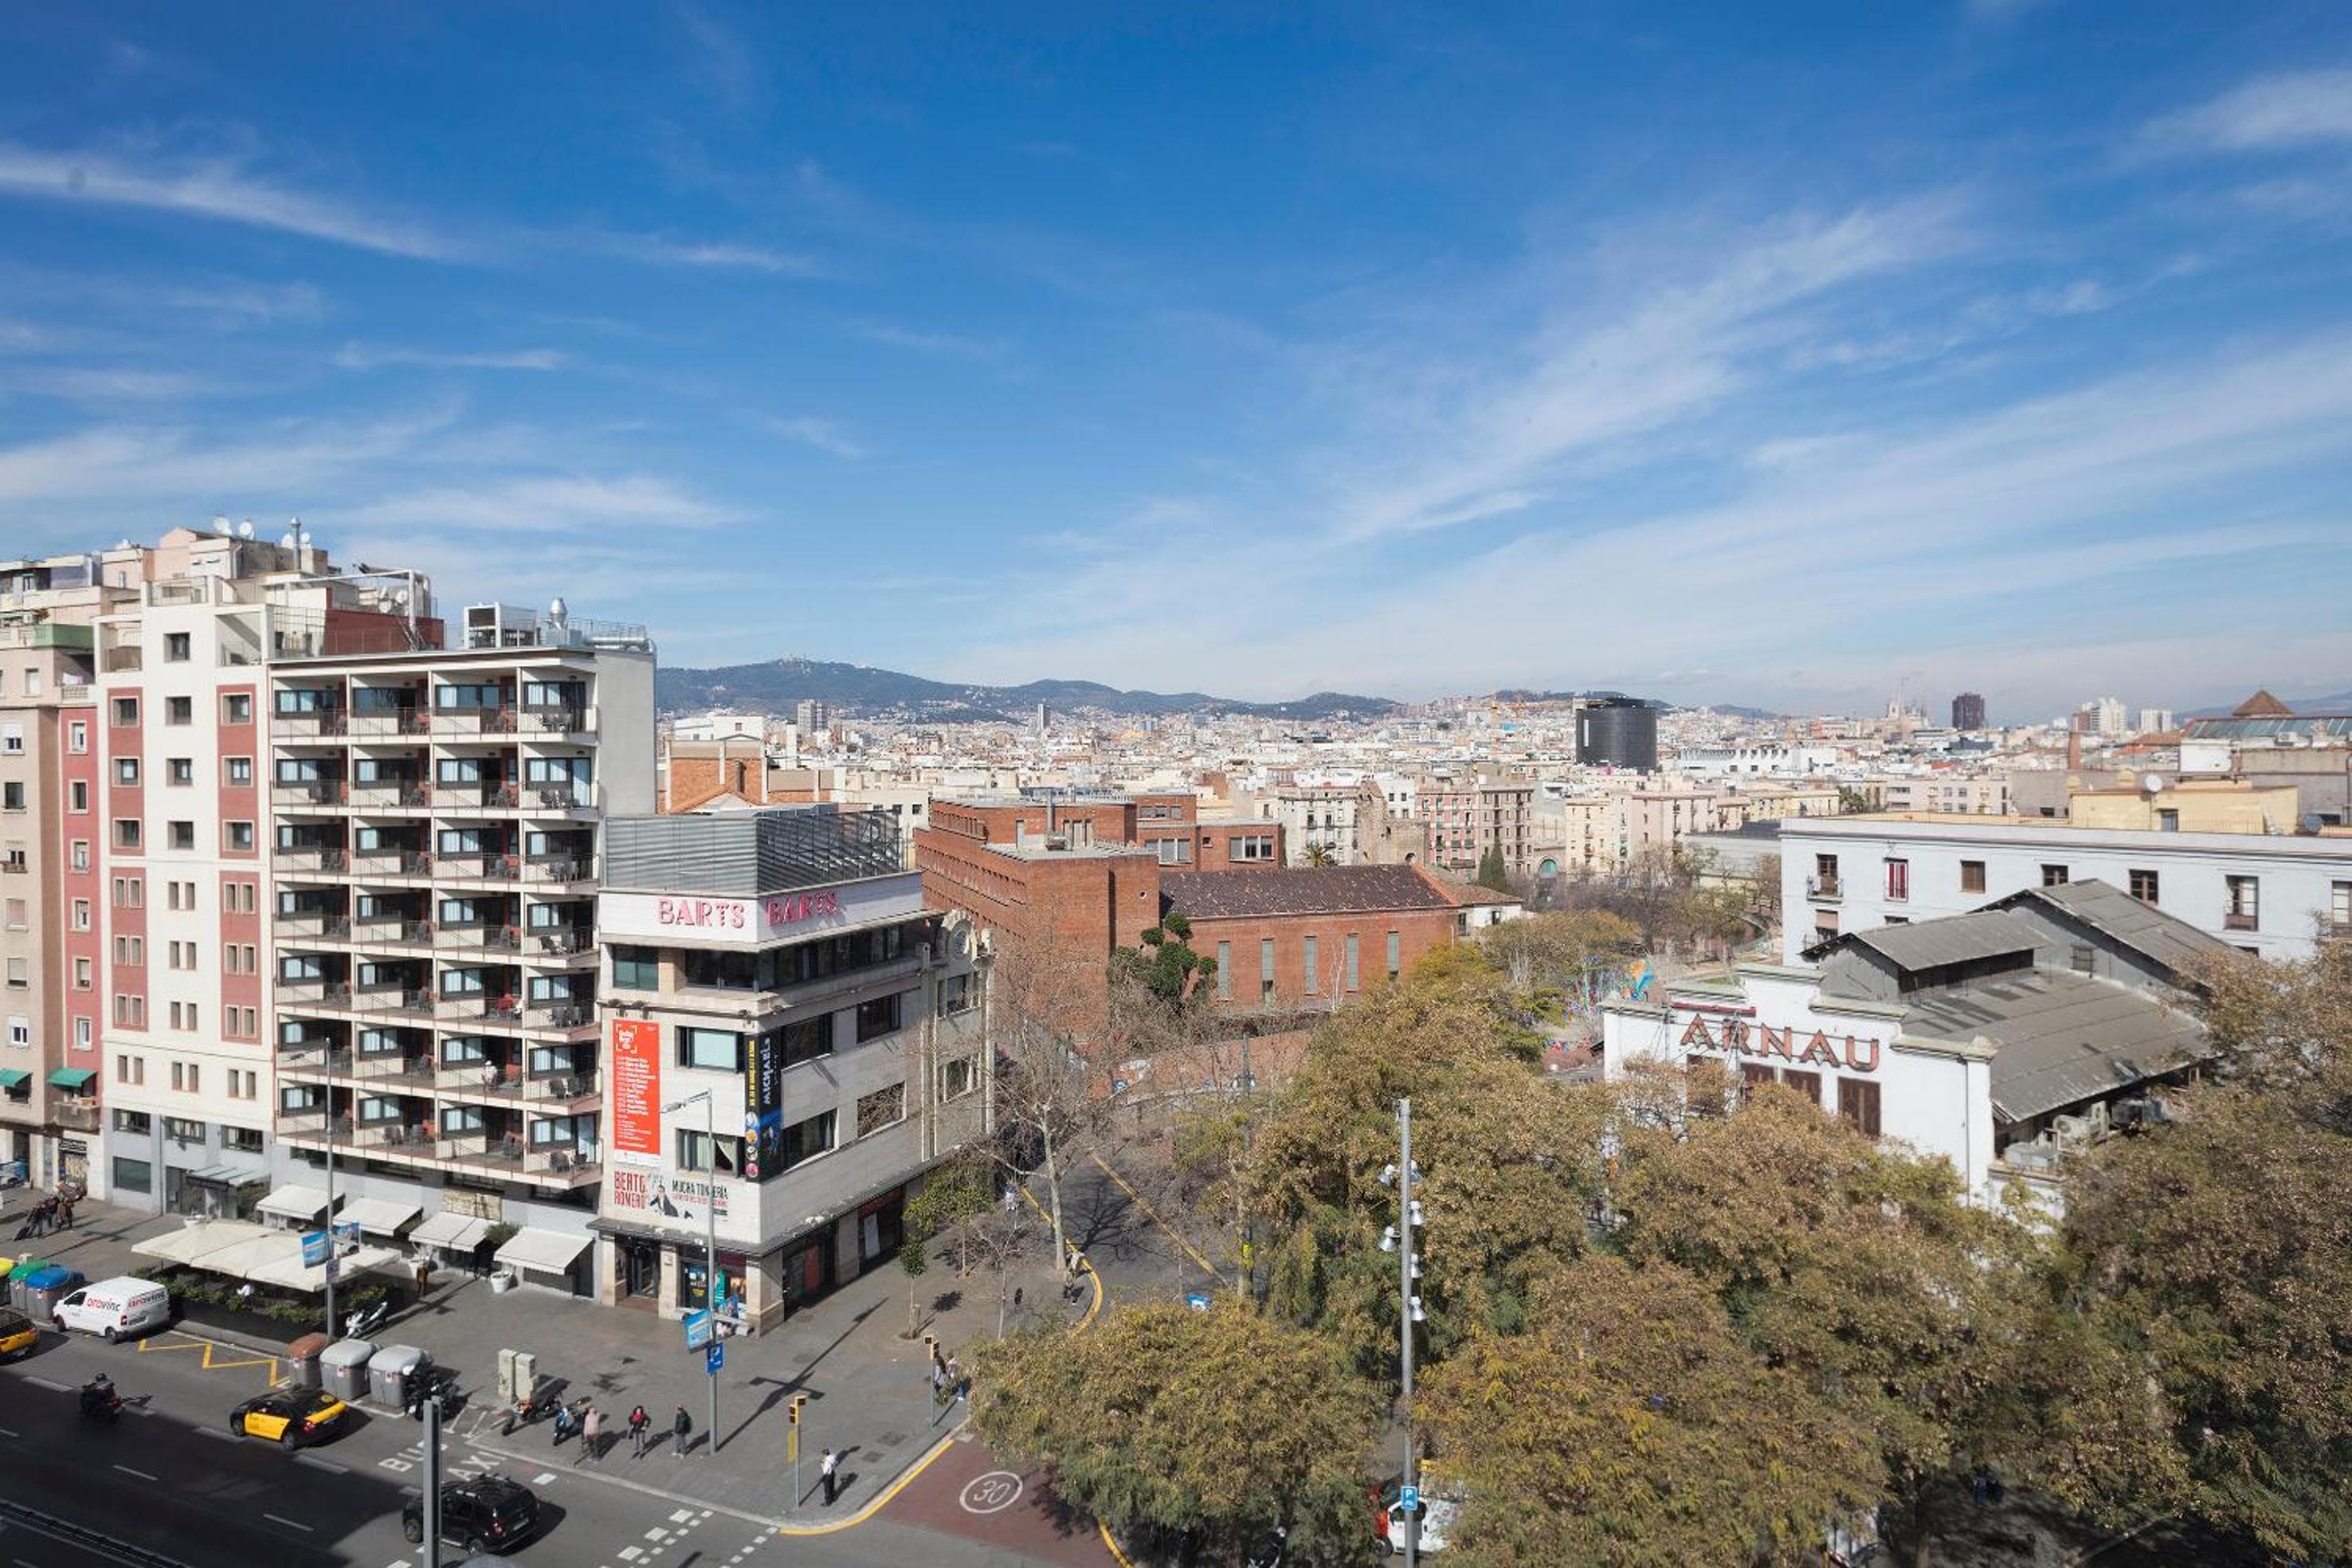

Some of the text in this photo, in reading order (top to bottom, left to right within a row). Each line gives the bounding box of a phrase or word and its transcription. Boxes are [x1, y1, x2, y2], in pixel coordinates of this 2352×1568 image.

[659, 897, 744, 929] BARTS
[766, 891, 838, 927] BARTS
[1680, 1013, 1880, 1072] ARNAU
[614, 1170, 645, 1194] BERTO
[672, 1179, 695, 1194] MUCHA
[696, 1182, 728, 1200] TONERÍA
[614, 1190, 647, 1209] ROMERO
[442, 1452, 507, 1483] AXI
[973, 1480, 1010, 1504] 30
[1405, 1489, 1412, 1498] P
